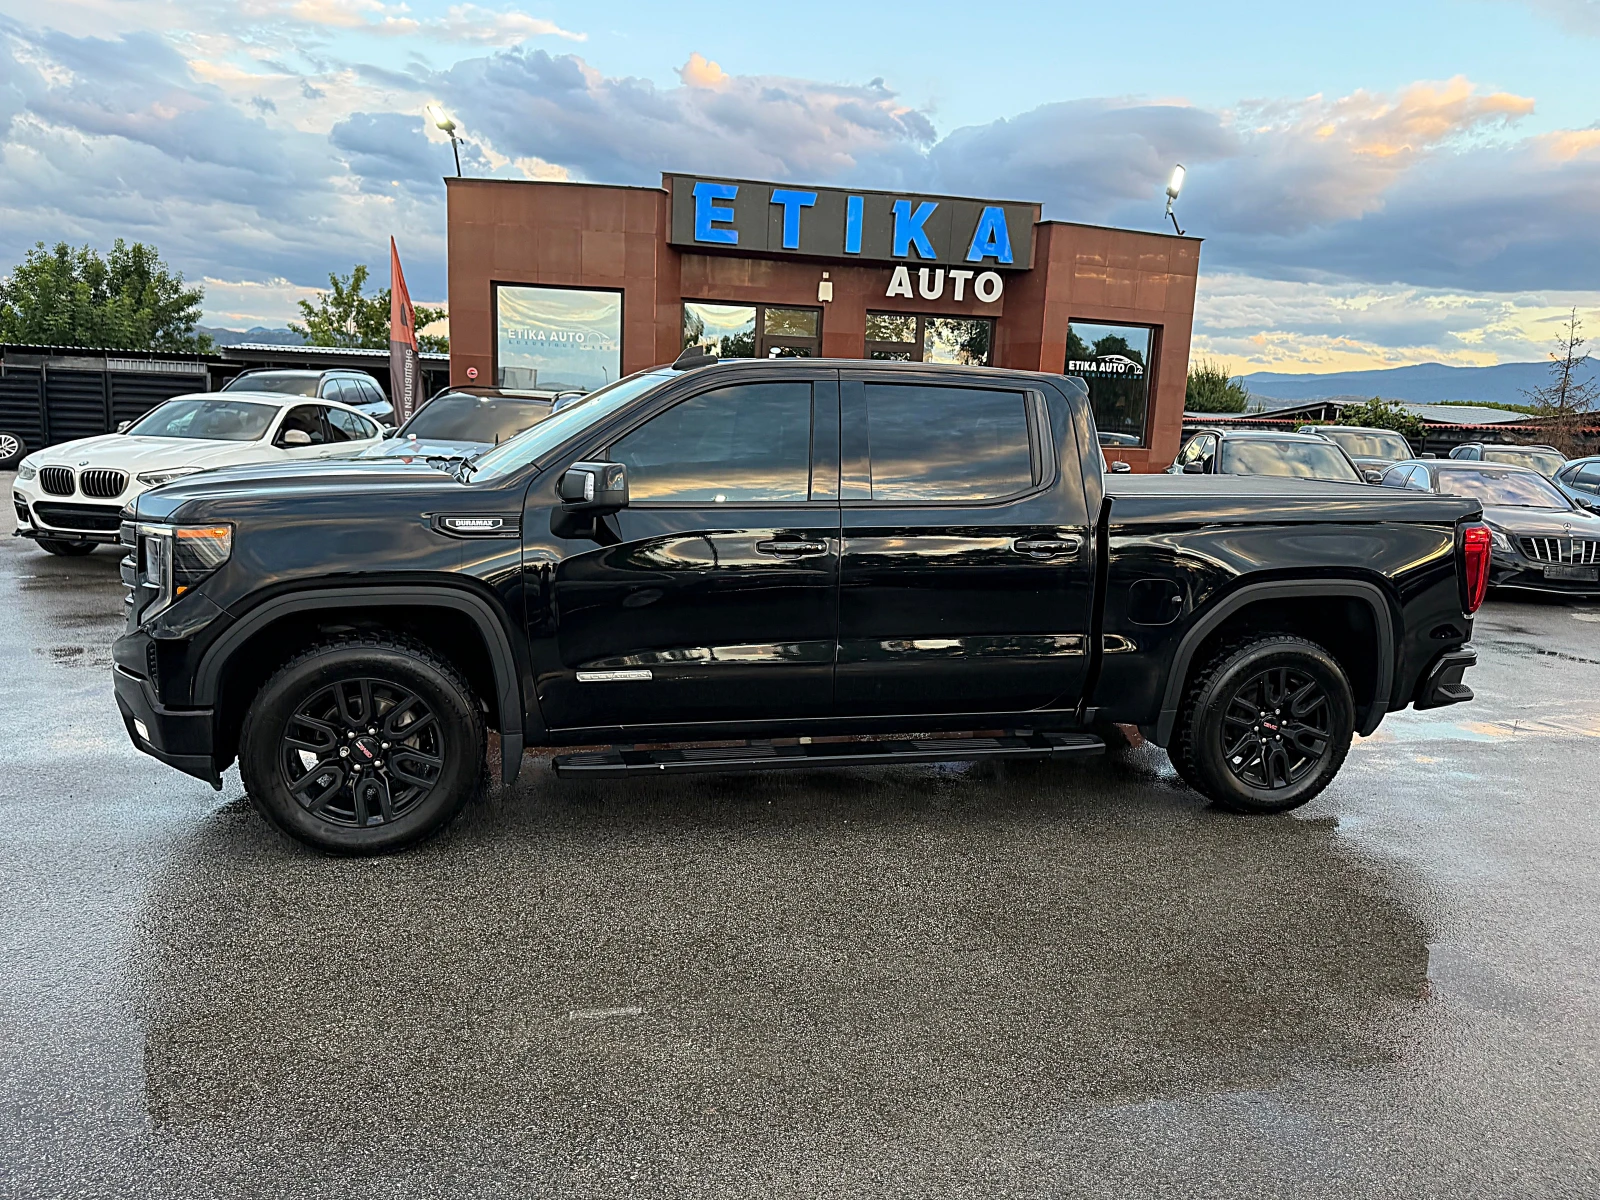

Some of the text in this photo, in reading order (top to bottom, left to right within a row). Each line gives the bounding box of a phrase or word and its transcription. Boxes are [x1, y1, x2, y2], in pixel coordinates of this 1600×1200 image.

[692, 182, 1014, 264] ETIKA
[886, 266, 1004, 303] AUTO
[508, 328, 585, 343] ETIKA AUTO
[1068, 360, 1126, 373] ETIKA AUTO
